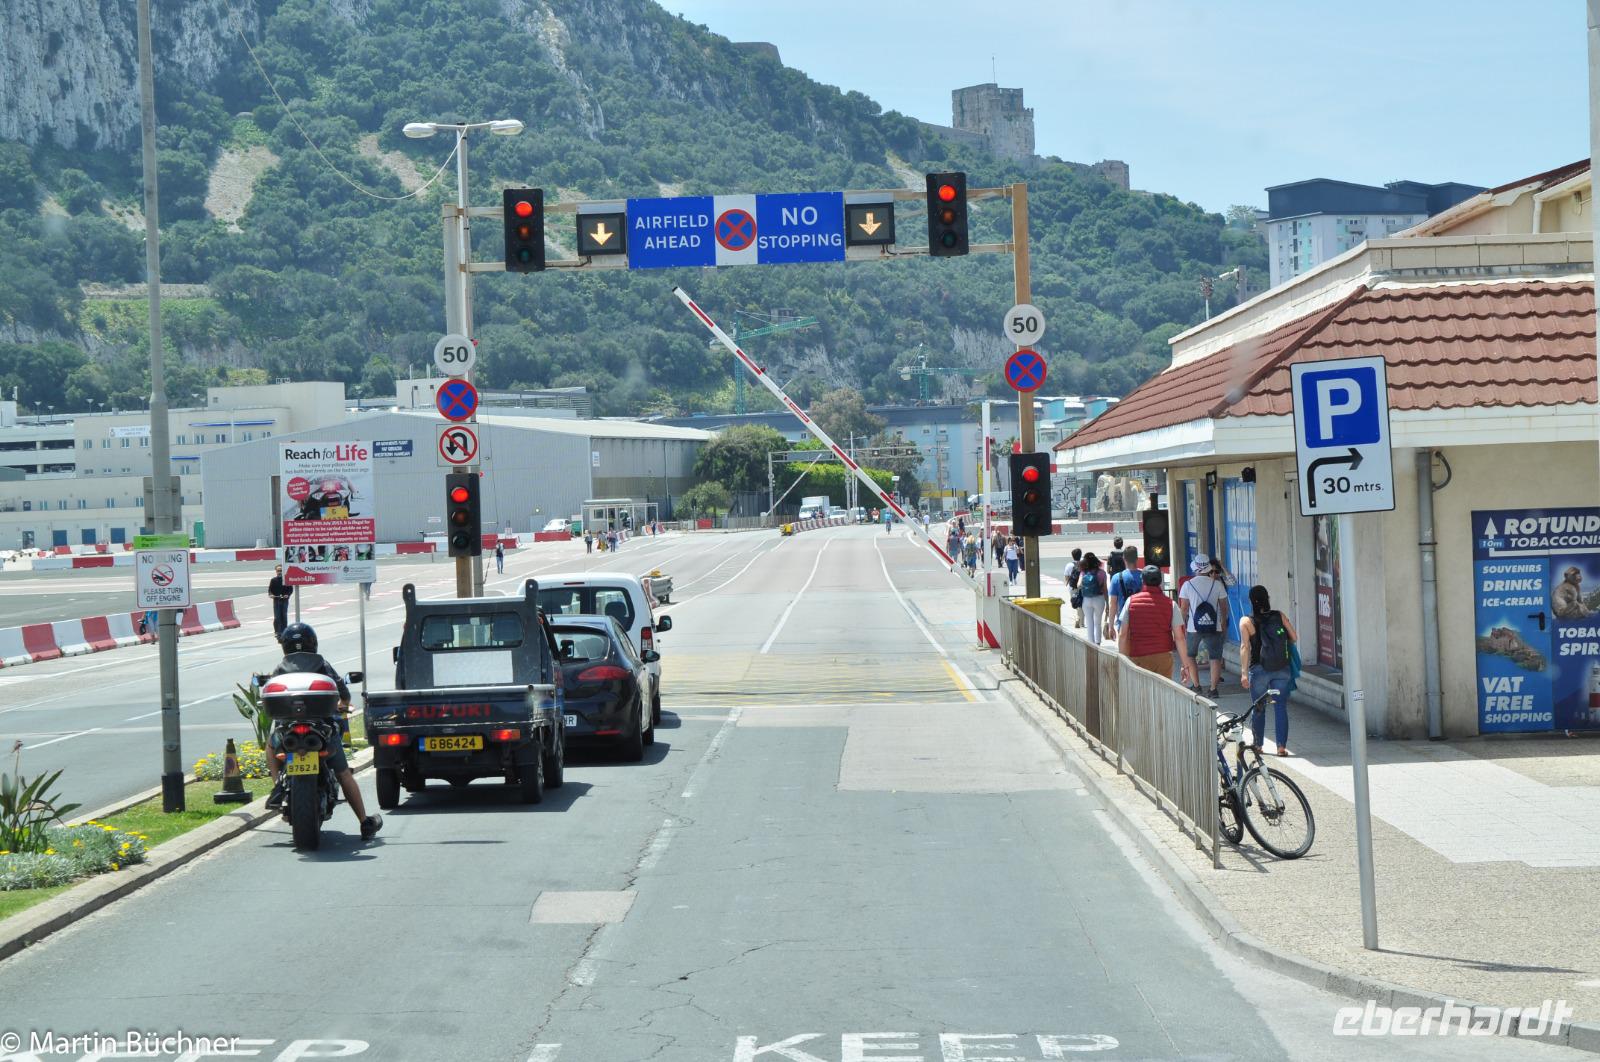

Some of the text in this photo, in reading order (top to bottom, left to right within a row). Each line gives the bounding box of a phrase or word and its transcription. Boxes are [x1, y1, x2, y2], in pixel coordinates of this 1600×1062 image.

[635, 214, 709, 230] AIRFIELD
[781, 206, 818, 226] NO
[644, 235, 701, 249] AHEAD
[758, 233, 842, 249] STOPPING
[1012, 316, 1038, 334] 50
[442, 346, 469, 363] 50
[1316, 377, 1362, 440] P
[285, 448, 320, 460] Reach
[336, 444, 368, 461] Life
[1322, 476, 1384, 494] 30 mtrs.
[1504, 515, 1600, 535] ROTUND
[1482, 540, 1502, 548] 10m
[142, 554, 154, 564] NO
[1482, 564, 1542, 574] SOUVENIRS
[1482, 579, 1542, 591] DRINKS
[1482, 596, 1544, 607] ICE-CREAM
[1558, 627, 1600, 638] TOBA
[1559, 642, 1600, 656] SPIR
[1482, 676, 1524, 693] VAT
[406, 703, 491, 719] SUZUKI
[1484, 695, 1534, 711] FREE
[1484, 712, 1552, 724] SHOPPING
[733, 1032, 1120, 1062] KEEP
